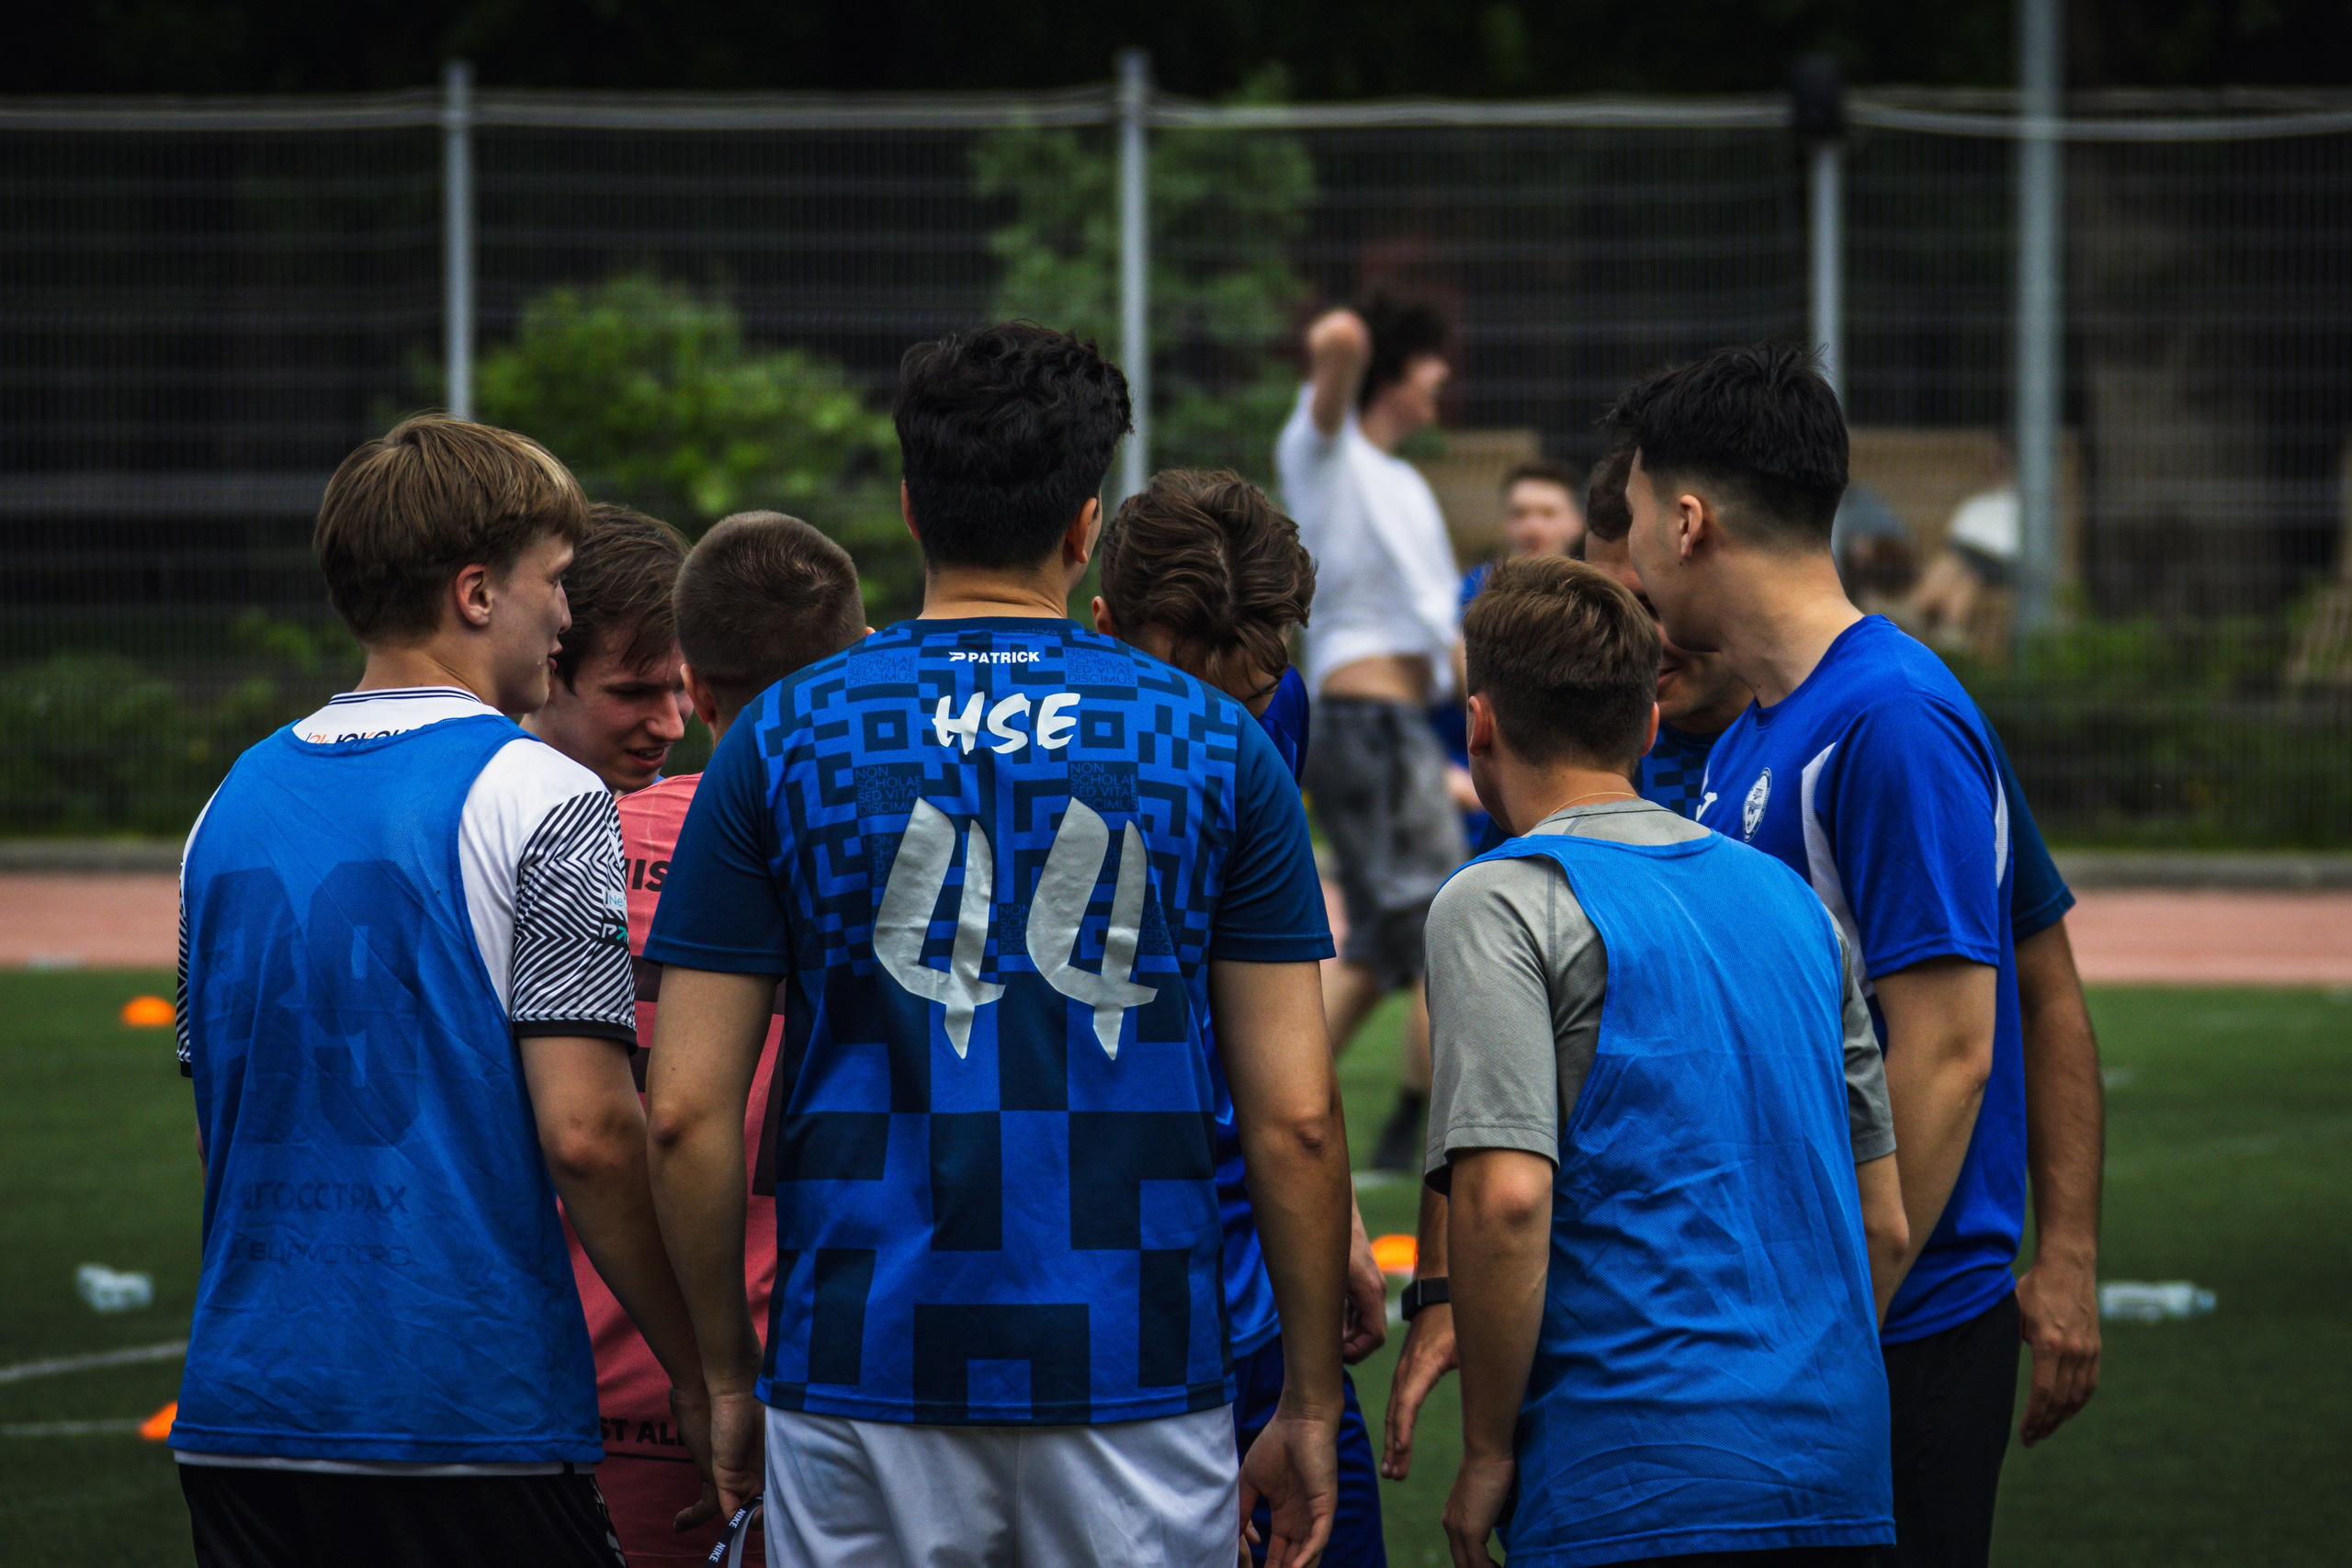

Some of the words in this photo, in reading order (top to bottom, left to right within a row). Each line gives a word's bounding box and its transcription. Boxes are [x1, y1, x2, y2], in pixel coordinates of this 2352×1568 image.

[850, 651, 885, 664] NON
[968, 652, 1039, 663] PATRICK
[1066, 649, 1100, 658] NON
[1067, 656, 1130, 669] SCHOLAE
[848, 667, 873, 678] SED
[877, 662, 915, 673] VITAE
[1068, 665, 1092, 673] SED
[1096, 666, 1132, 676] VITAE
[848, 672, 917, 687] DISCIMUS
[1068, 673, 1136, 686] DISCIMUS
[932, 692, 1080, 755] HSE
[855, 765, 889, 780] NON
[1070, 762, 1105, 774] NON
[856, 775, 922, 793] SCHOLAE
[1070, 773, 1137, 786] SCHOLAE
[857, 790, 883, 805] SED
[1070, 785, 1097, 797] SED
[1101, 785, 1137, 797] VITAE
[859, 800, 915, 817] DISCIMU
[1082, 798, 1139, 810] SCIMUS
[874, 797, 1158, 1060] 44
[1000, 929, 1025, 942] SED
[729, 1508, 746, 1529] NIKE
[708, 1541, 726, 1562] NIKE
